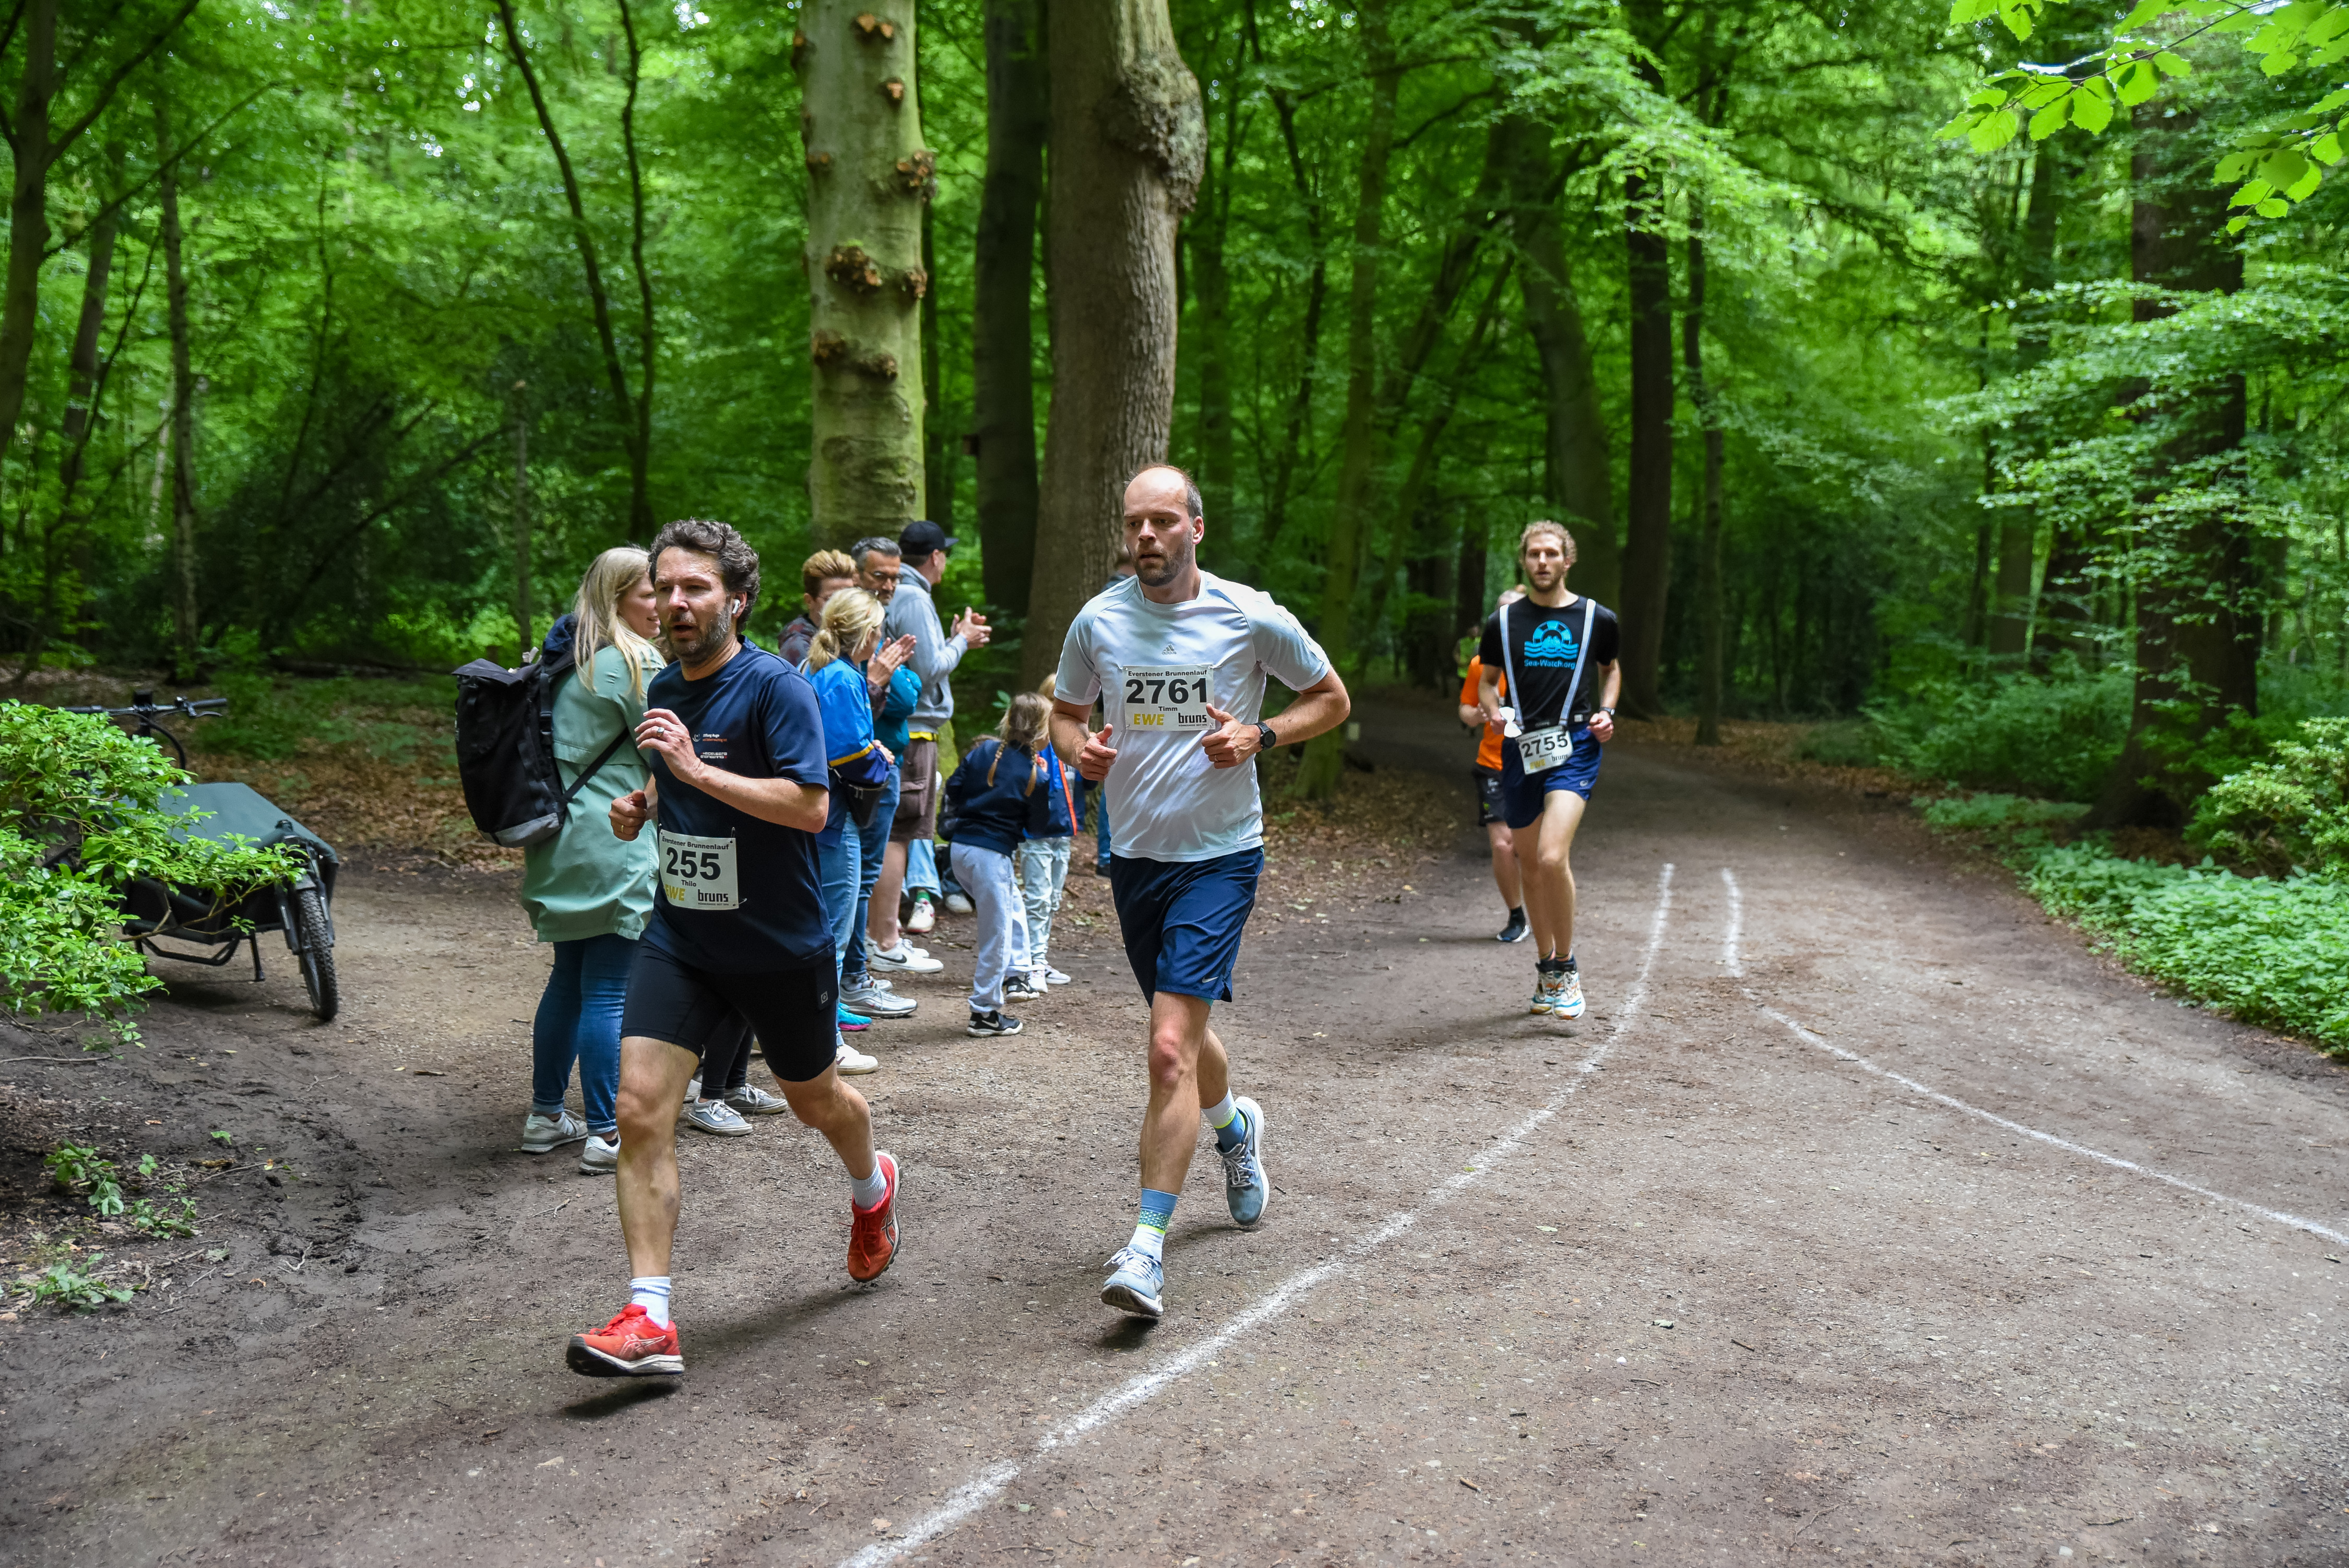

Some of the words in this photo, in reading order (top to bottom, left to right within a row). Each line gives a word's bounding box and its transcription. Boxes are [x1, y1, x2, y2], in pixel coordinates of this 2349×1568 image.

[1524, 659, 1576, 670] Sea-Watch.org
[1125, 678, 1207, 704] 2761
[1133, 714, 1165, 725] EWE
[1178, 712, 1207, 723] bruns
[1521, 733, 1568, 758] 2755
[662, 836, 686, 846] Everstener
[687, 841, 729, 850] Brunnenlauf
[666, 847, 721, 881] 255
[665, 884, 686, 901] EWE
[697, 889, 729, 902] bruns
